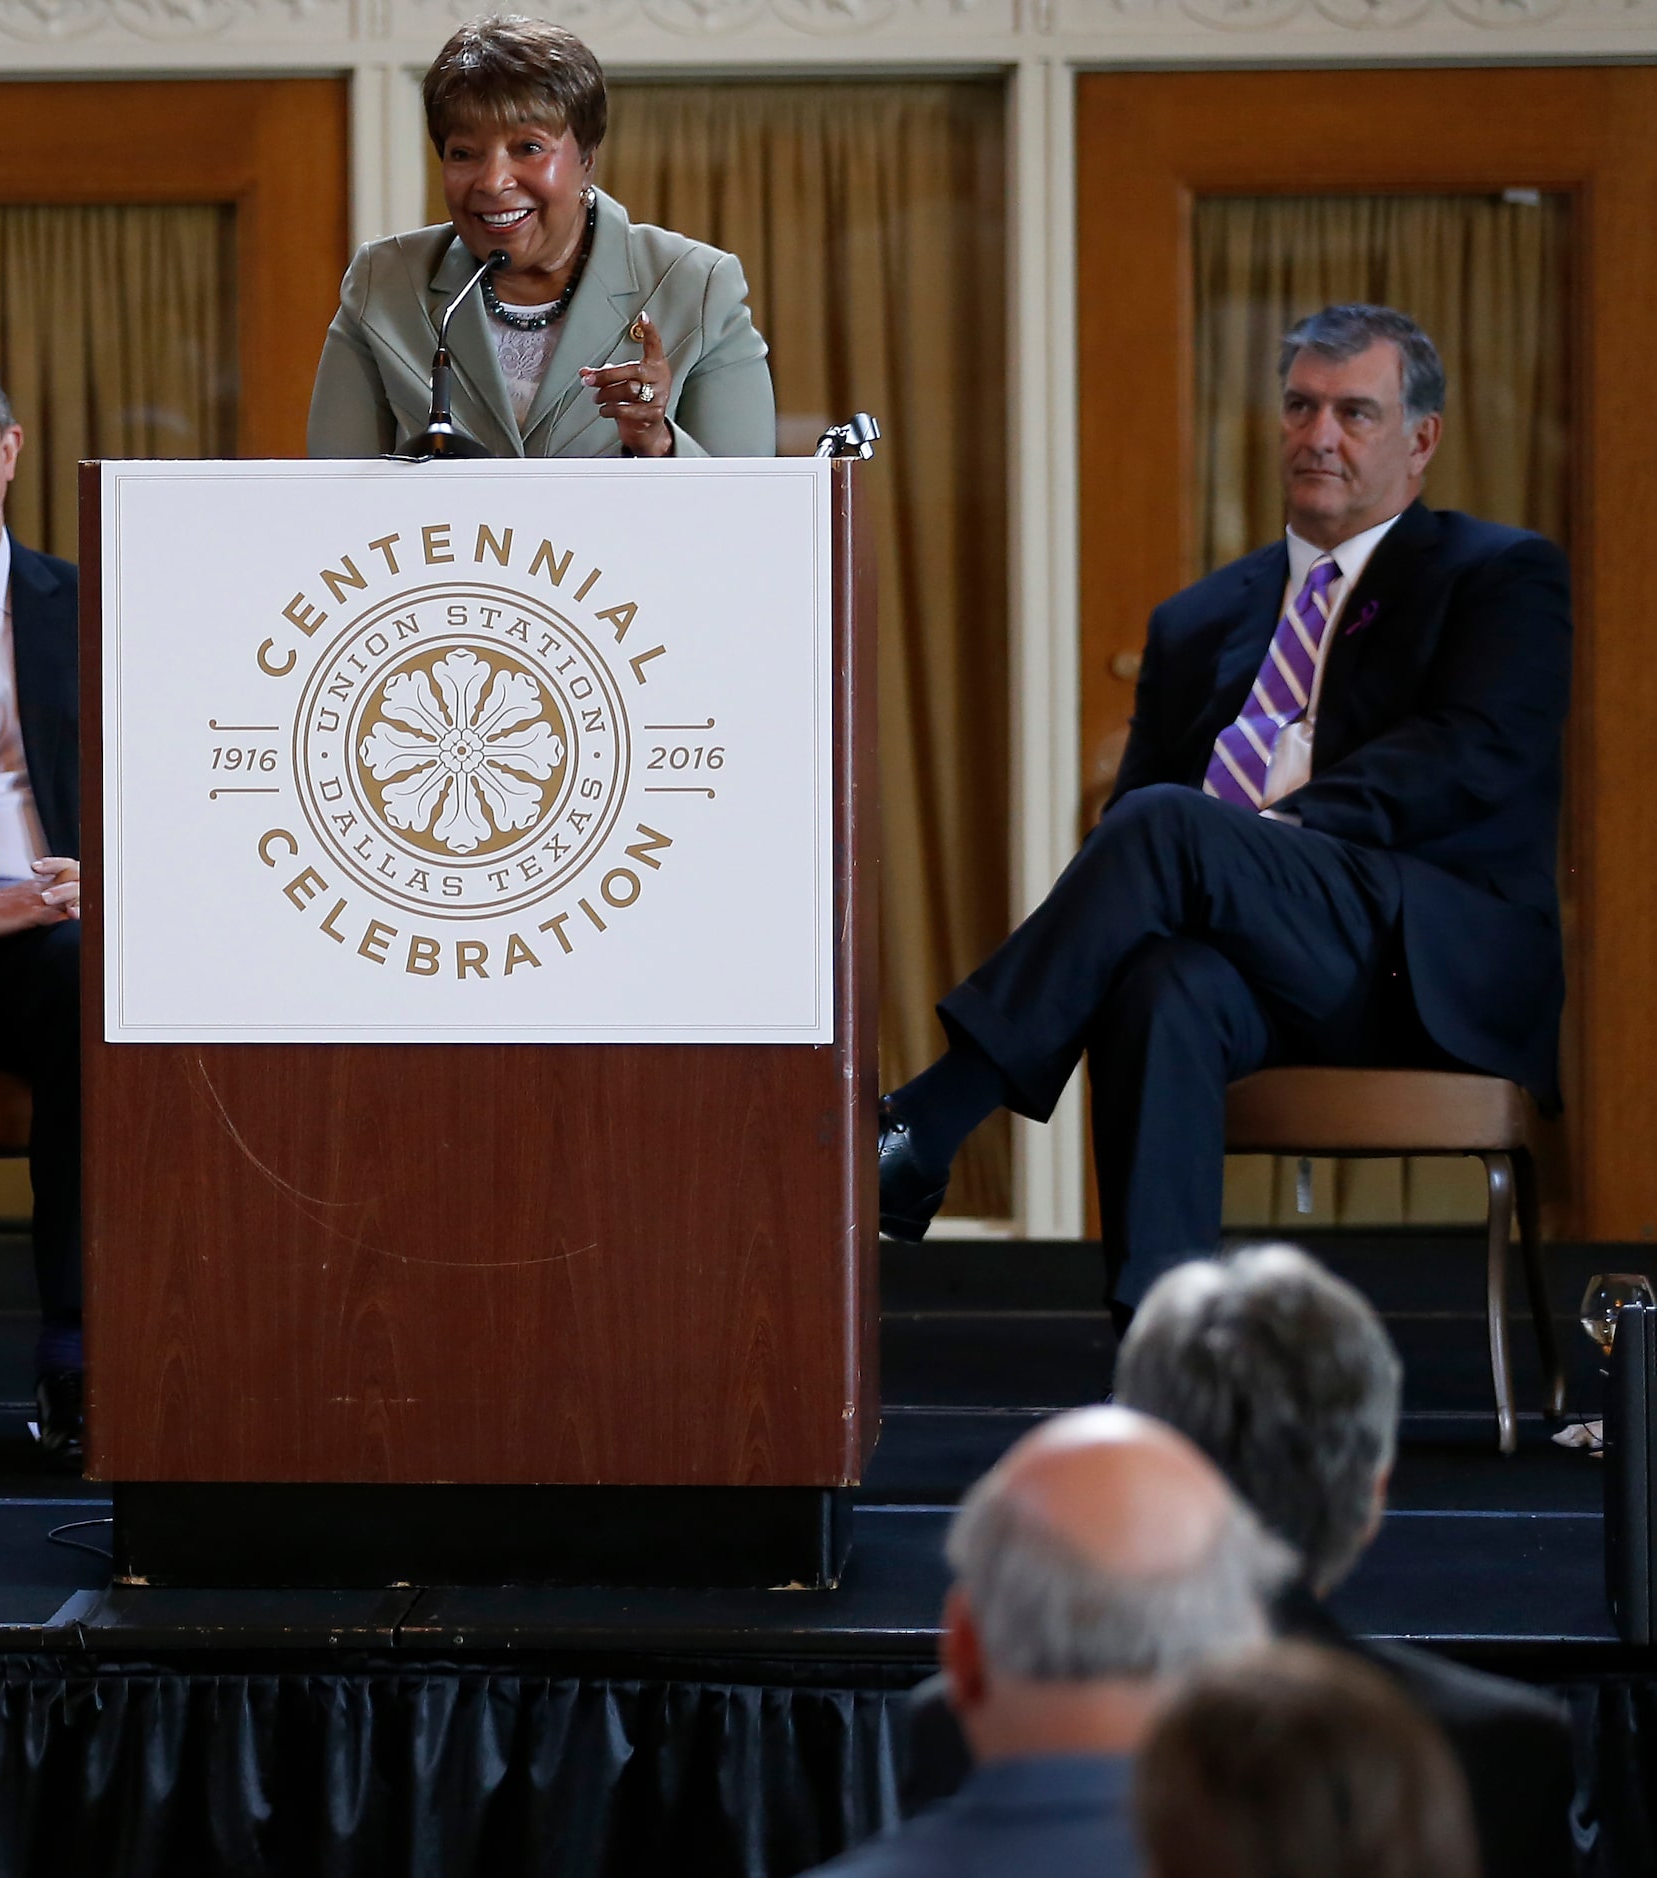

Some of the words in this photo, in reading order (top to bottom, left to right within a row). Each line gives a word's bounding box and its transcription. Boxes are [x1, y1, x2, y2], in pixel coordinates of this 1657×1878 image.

[256, 524, 667, 685] CENTENNIAL
[316, 612, 420, 733] UNION
[446, 604, 607, 735] STATION
[209, 745, 279, 773] 1916
[646, 745, 726, 771] 2016
[318, 776, 464, 897] DALLAS
[487, 776, 603, 893] TEXAS
[257, 823, 673, 980] CELEBRATION
